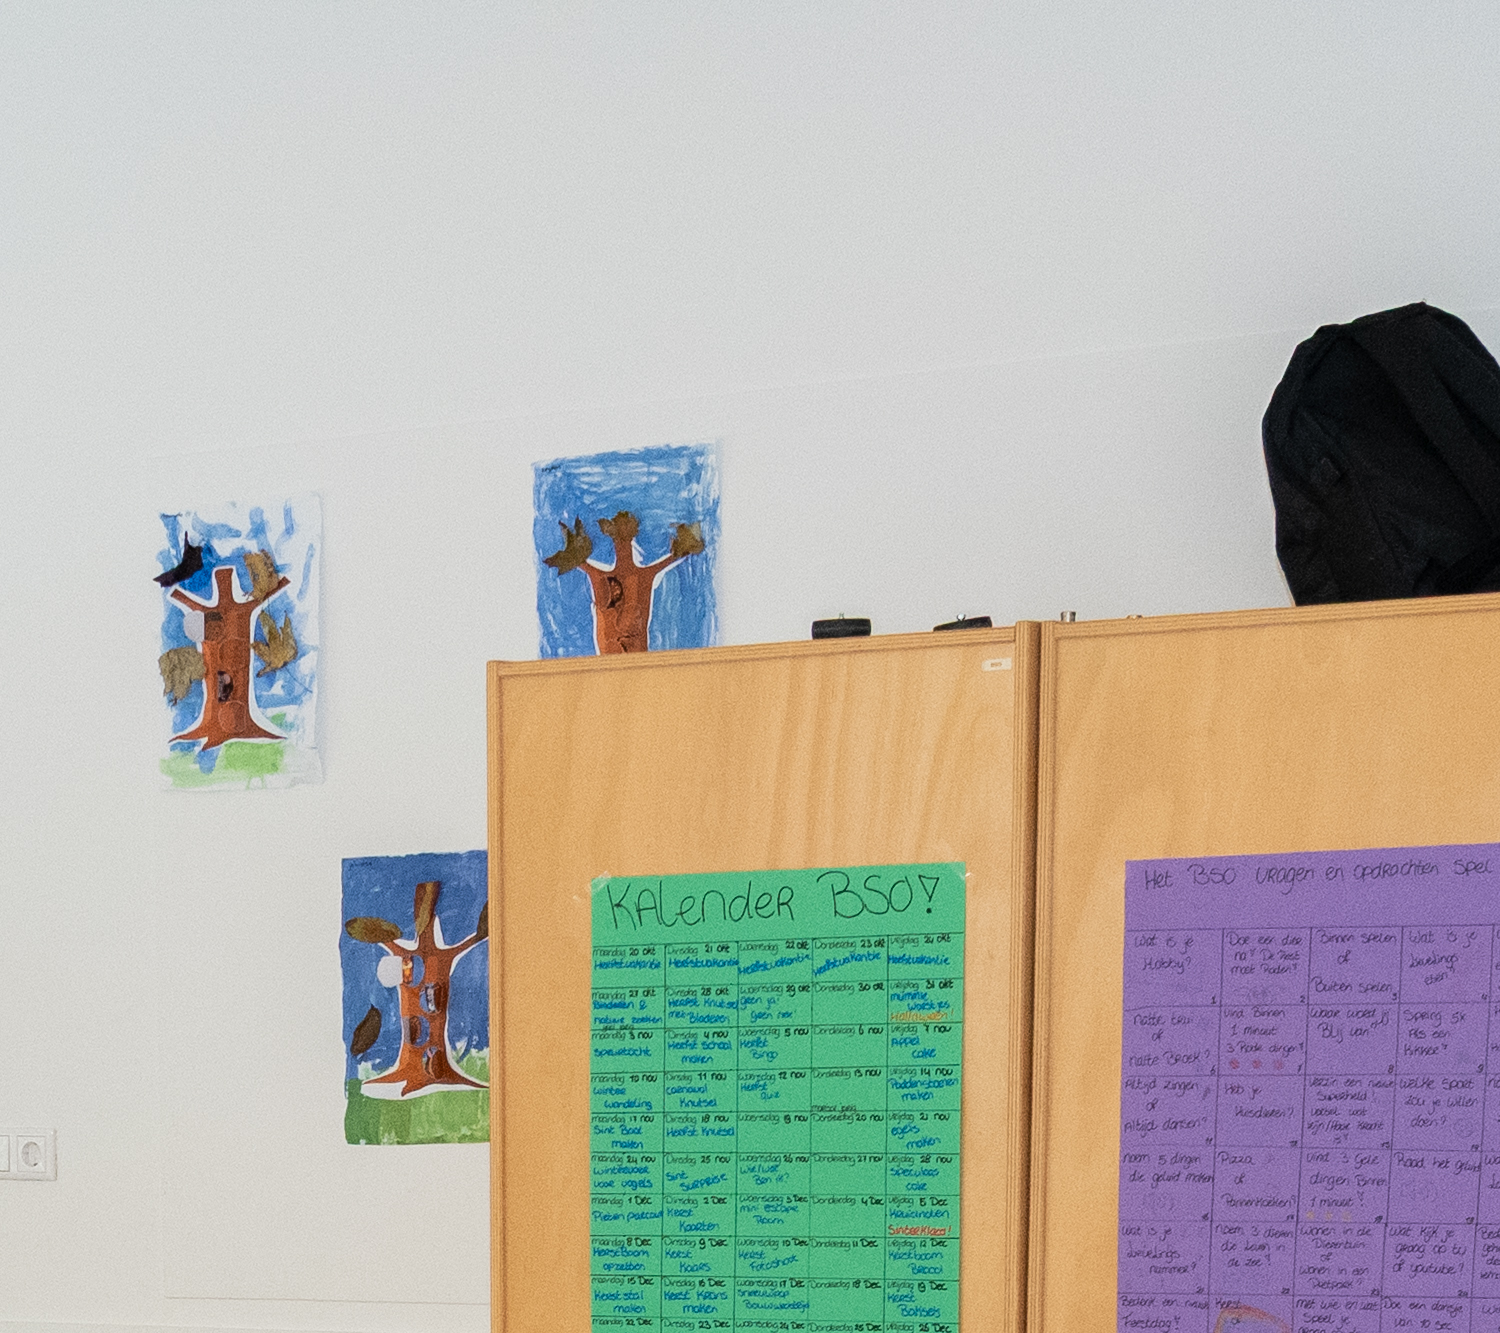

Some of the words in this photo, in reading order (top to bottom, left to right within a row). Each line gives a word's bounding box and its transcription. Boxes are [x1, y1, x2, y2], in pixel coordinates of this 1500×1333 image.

[1145, 870, 1173, 890] Het
[1187, 864, 1236, 885] BSO
[1326, 866, 1344, 880] en
[638, 1031, 653, 1039] nov
[935, 1068, 953, 1076] nov
[642, 1073, 657, 1082] nov
[714, 1114, 729, 1122] nov
[870, 1113, 884, 1121] nov
[641, 1155, 656, 1163] nov
[715, 1155, 731, 1163] nov
[699, 1321, 711, 1329] 23
[714, 1320, 731, 1328] Dec
